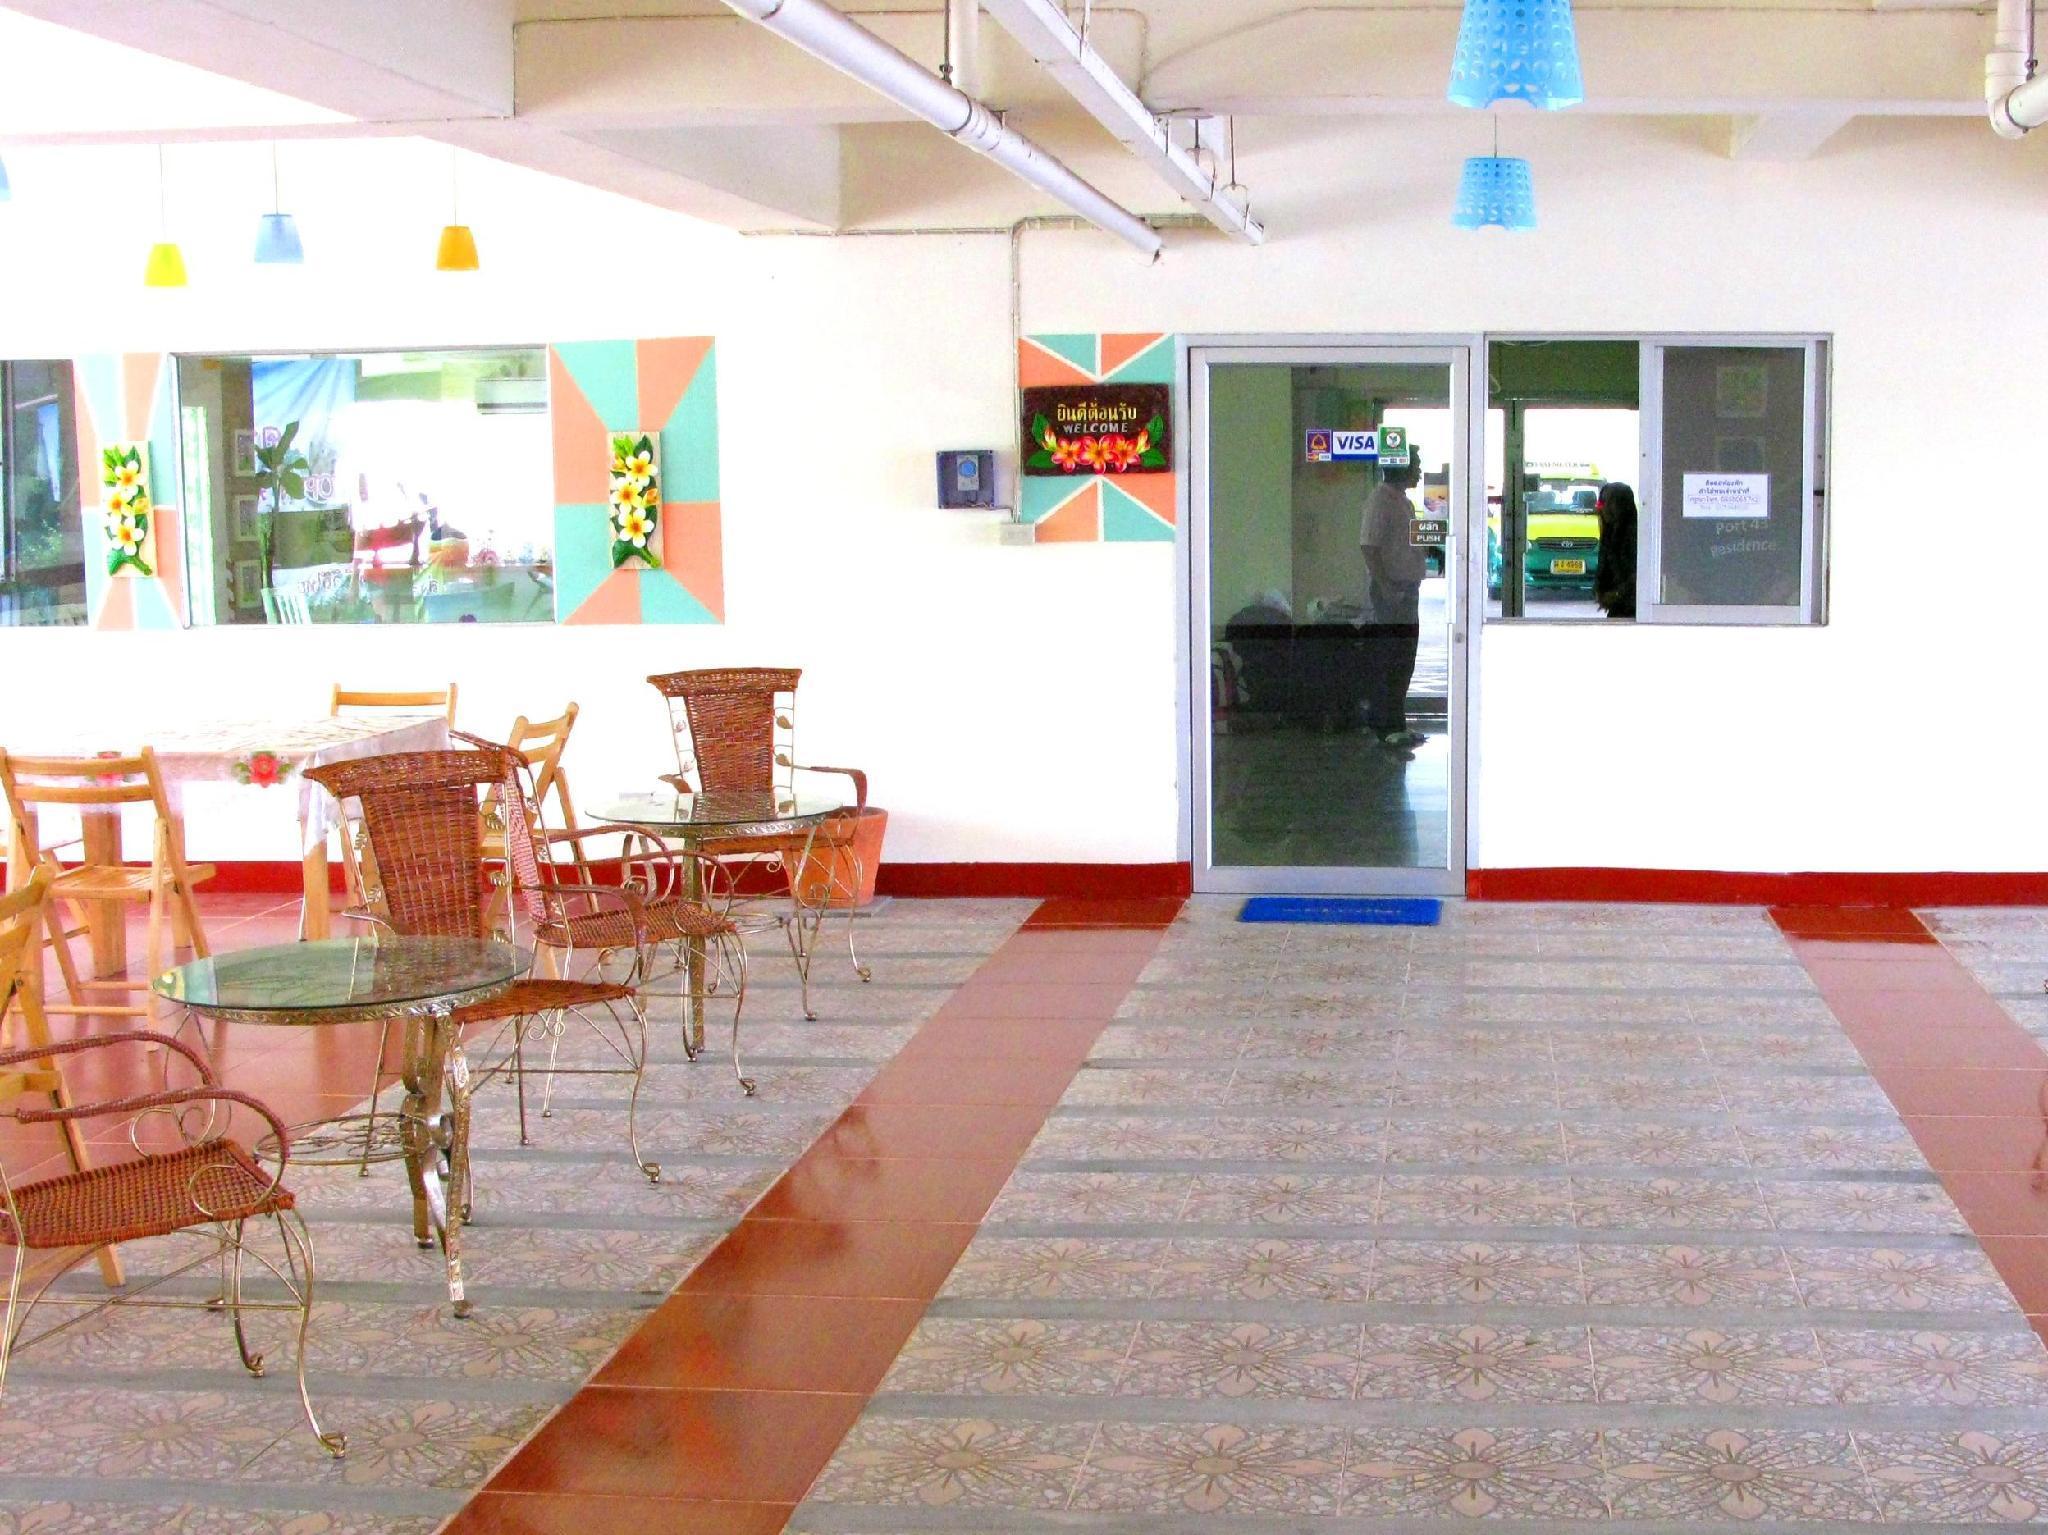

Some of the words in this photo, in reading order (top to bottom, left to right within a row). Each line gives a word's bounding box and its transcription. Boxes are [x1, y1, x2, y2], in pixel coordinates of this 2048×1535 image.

[1057, 400, 1138, 421] ยินดีต้อนรับ
[1063, 422, 1129, 434] WELCOME
[1336, 435, 1376, 450] VISA
[1418, 521, 1439, 531] ผลัก
